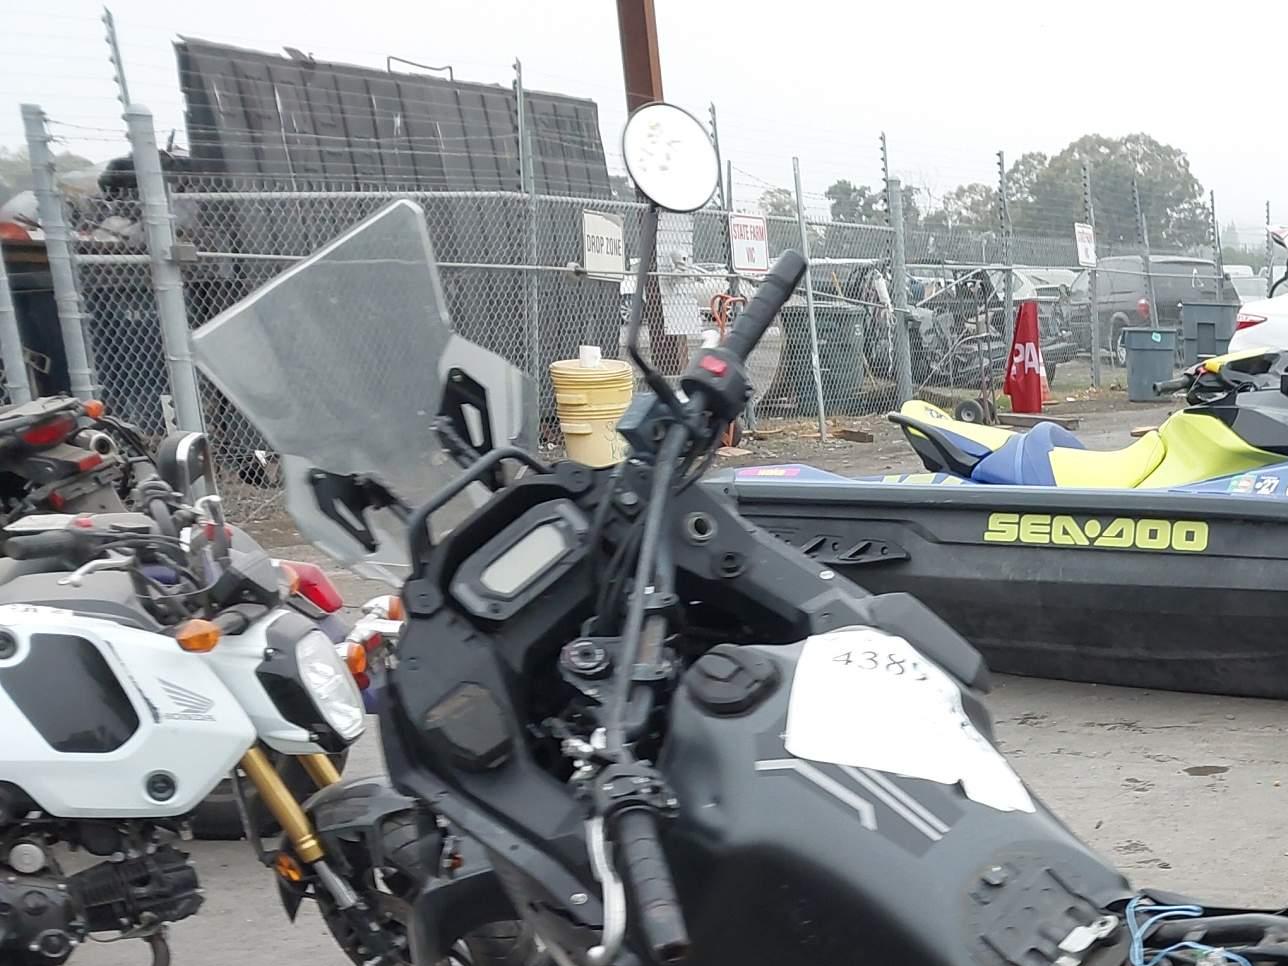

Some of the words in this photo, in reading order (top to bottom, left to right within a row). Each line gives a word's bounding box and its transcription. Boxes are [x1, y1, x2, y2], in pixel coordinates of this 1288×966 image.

[732, 223, 749, 241] STATE
[749, 224, 765, 242] FARM
[586, 234, 604, 255] DROP
[605, 236, 622, 257] ZONE
